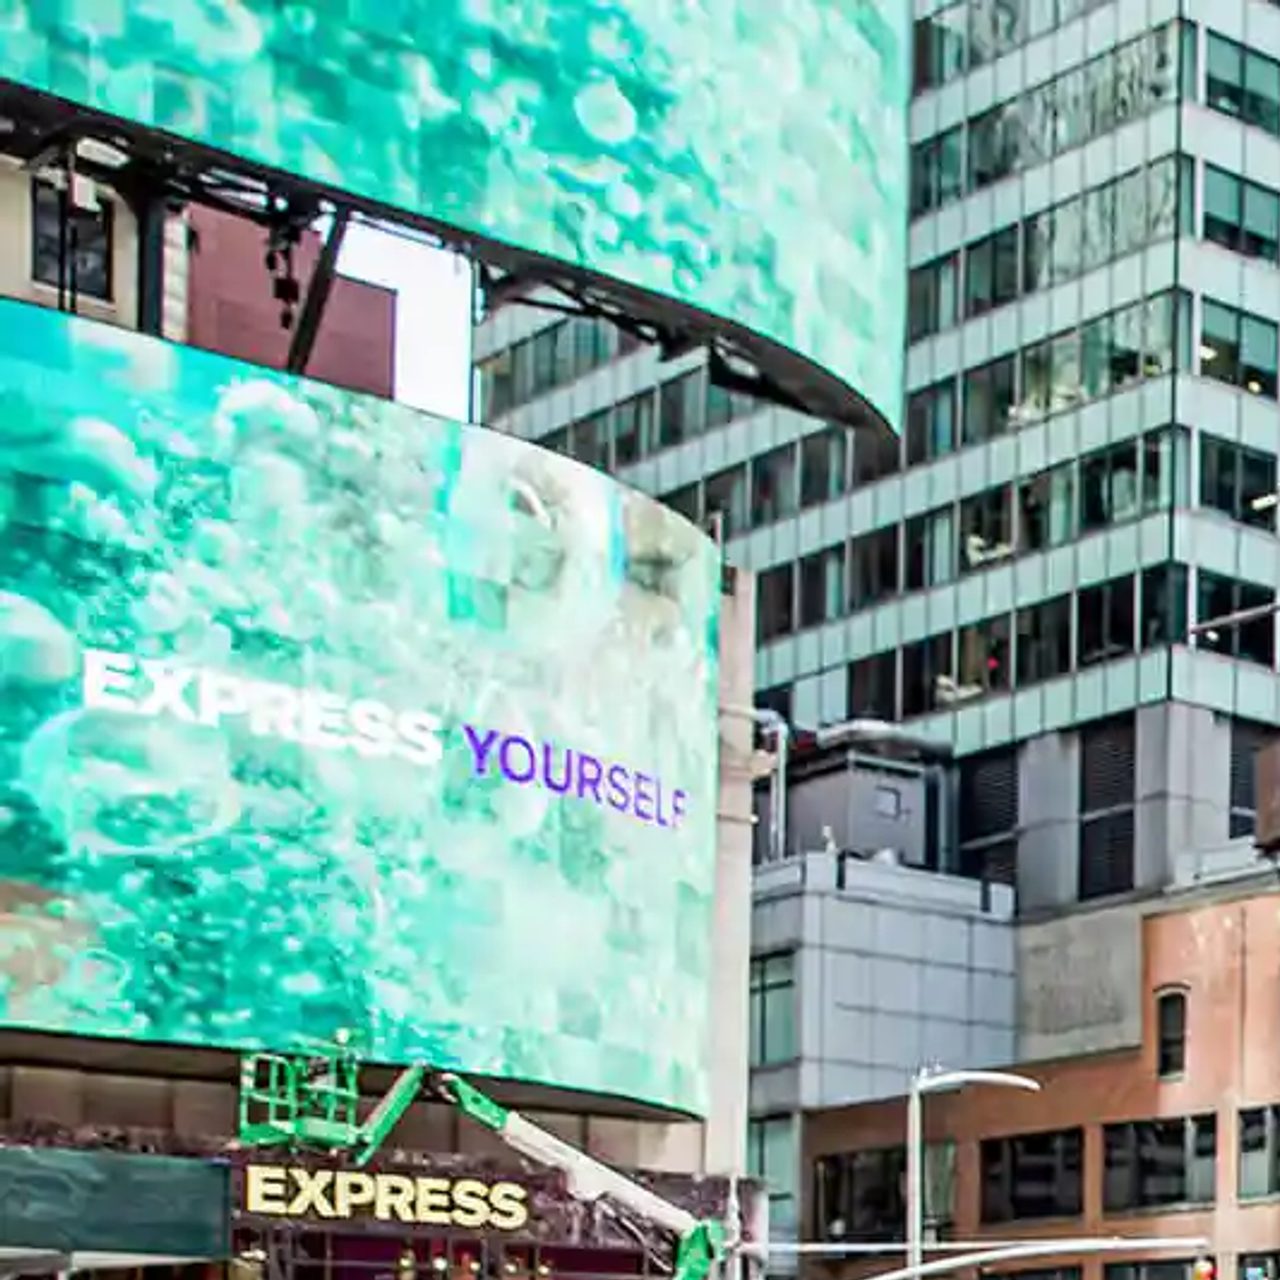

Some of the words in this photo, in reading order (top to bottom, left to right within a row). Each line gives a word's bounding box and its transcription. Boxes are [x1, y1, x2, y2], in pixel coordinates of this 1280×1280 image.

[80, 649, 445, 766] EXPRESS
[460, 724, 688, 830] YOURSELF
[246, 1165, 528, 1230] EXPRESS
